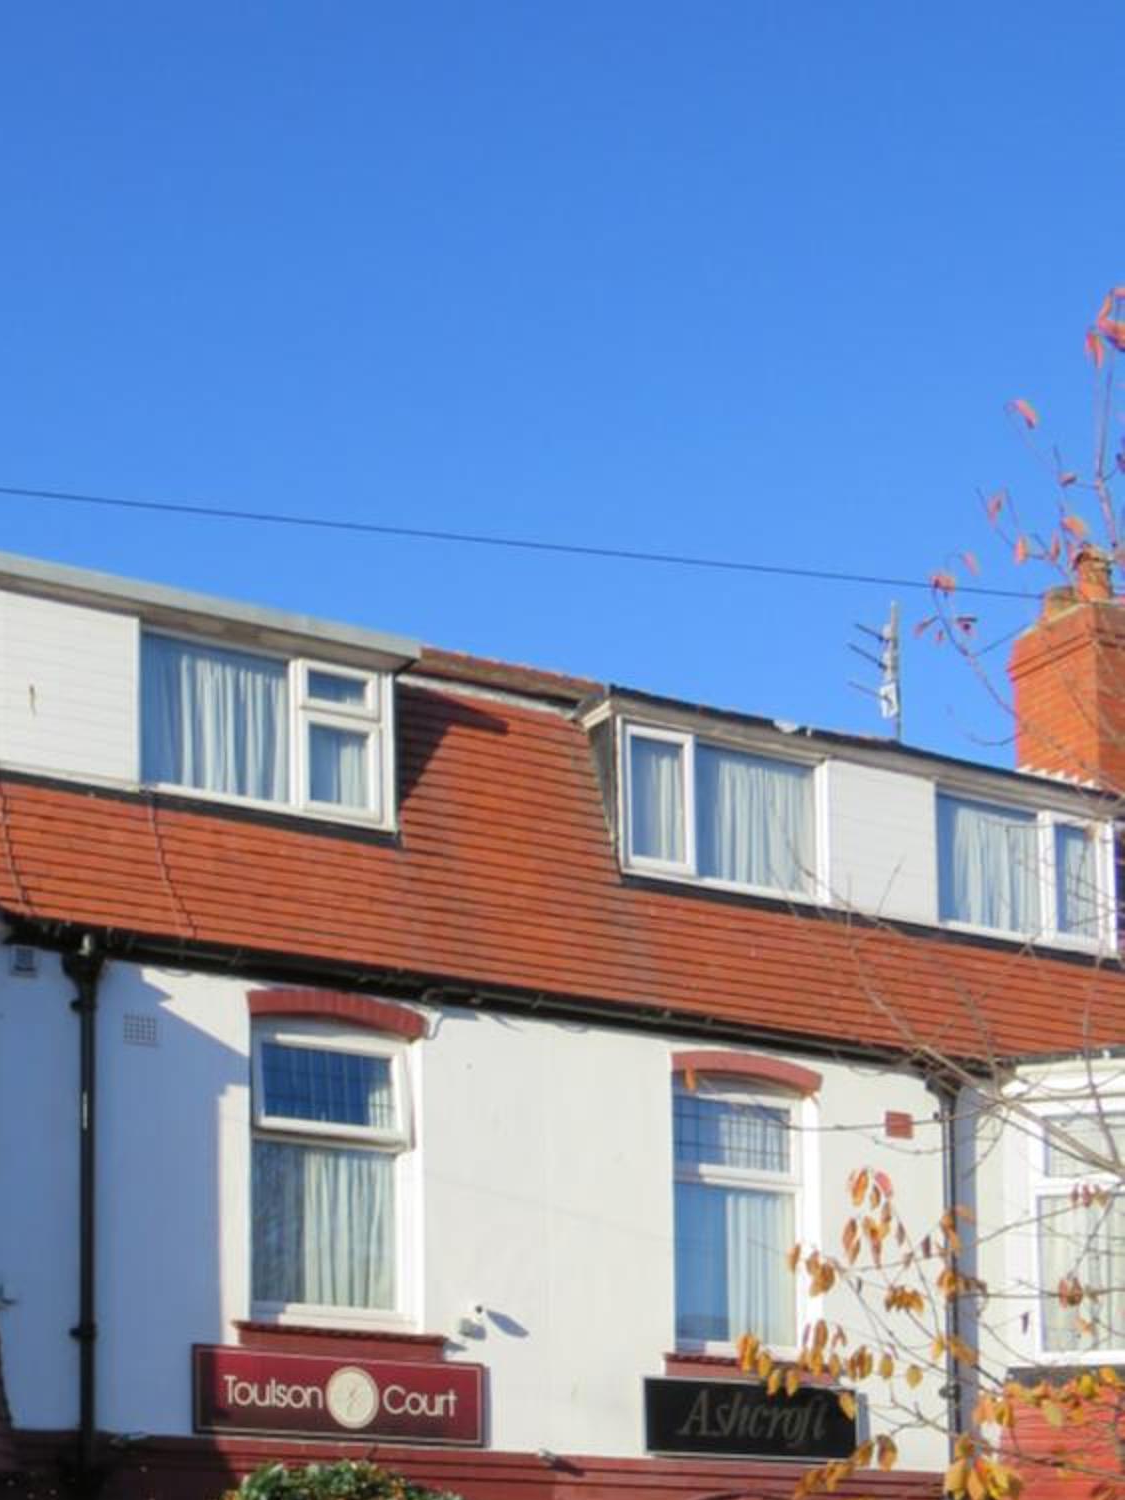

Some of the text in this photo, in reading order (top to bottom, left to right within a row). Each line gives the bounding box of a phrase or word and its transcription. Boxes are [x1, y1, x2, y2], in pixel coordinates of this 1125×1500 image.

[223, 1374, 458, 1417] Toulson Court
[676, 1388, 827, 1447] Ashcroft
